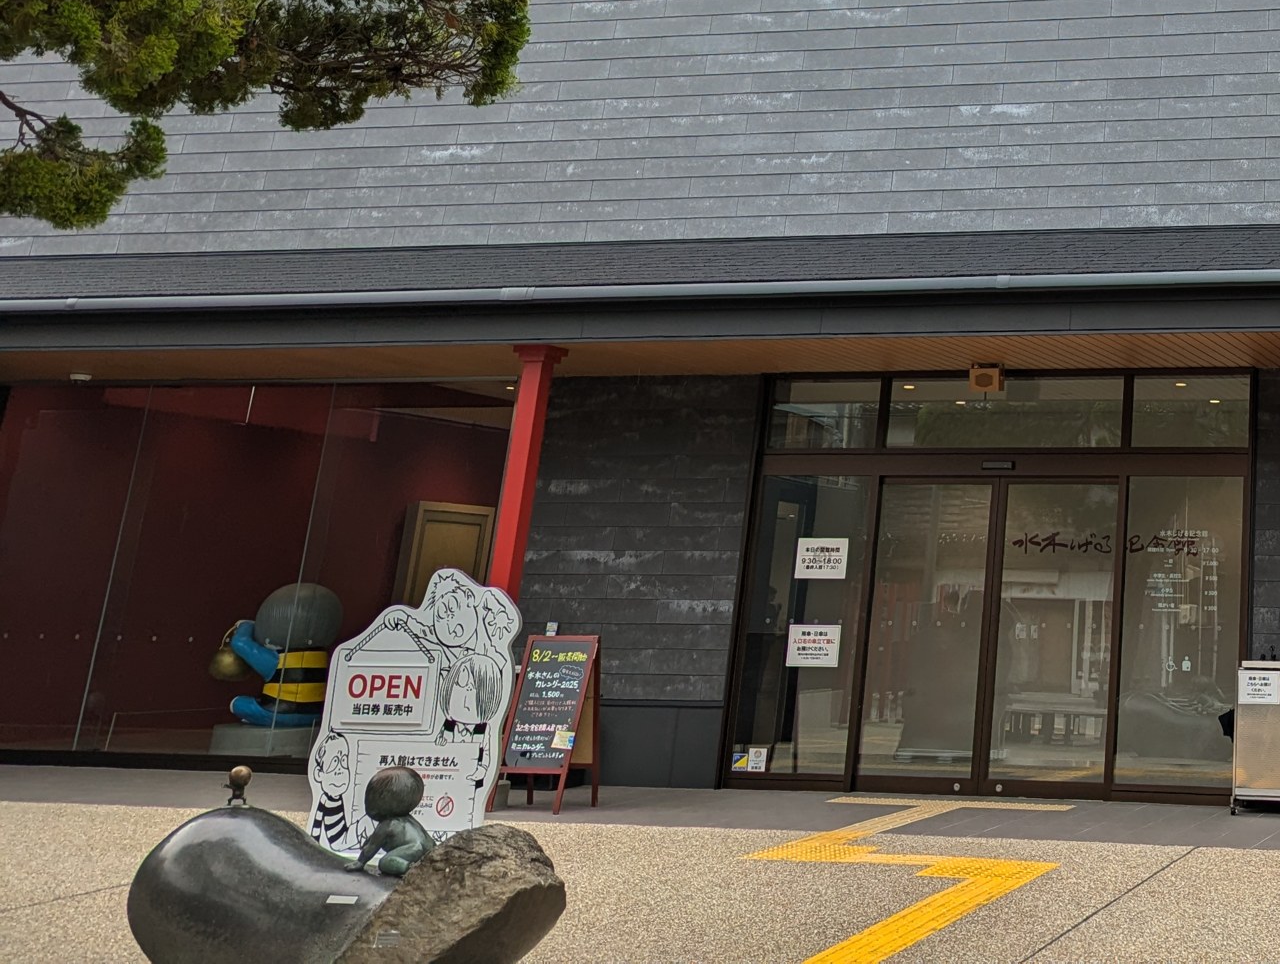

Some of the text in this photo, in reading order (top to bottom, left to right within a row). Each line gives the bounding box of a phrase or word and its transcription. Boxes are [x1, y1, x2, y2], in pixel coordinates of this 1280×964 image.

[348, 674, 422, 699] OPEN
[352, 704, 413, 716] 当日券 販売中
[379, 754, 459, 767] 再入館はできません
